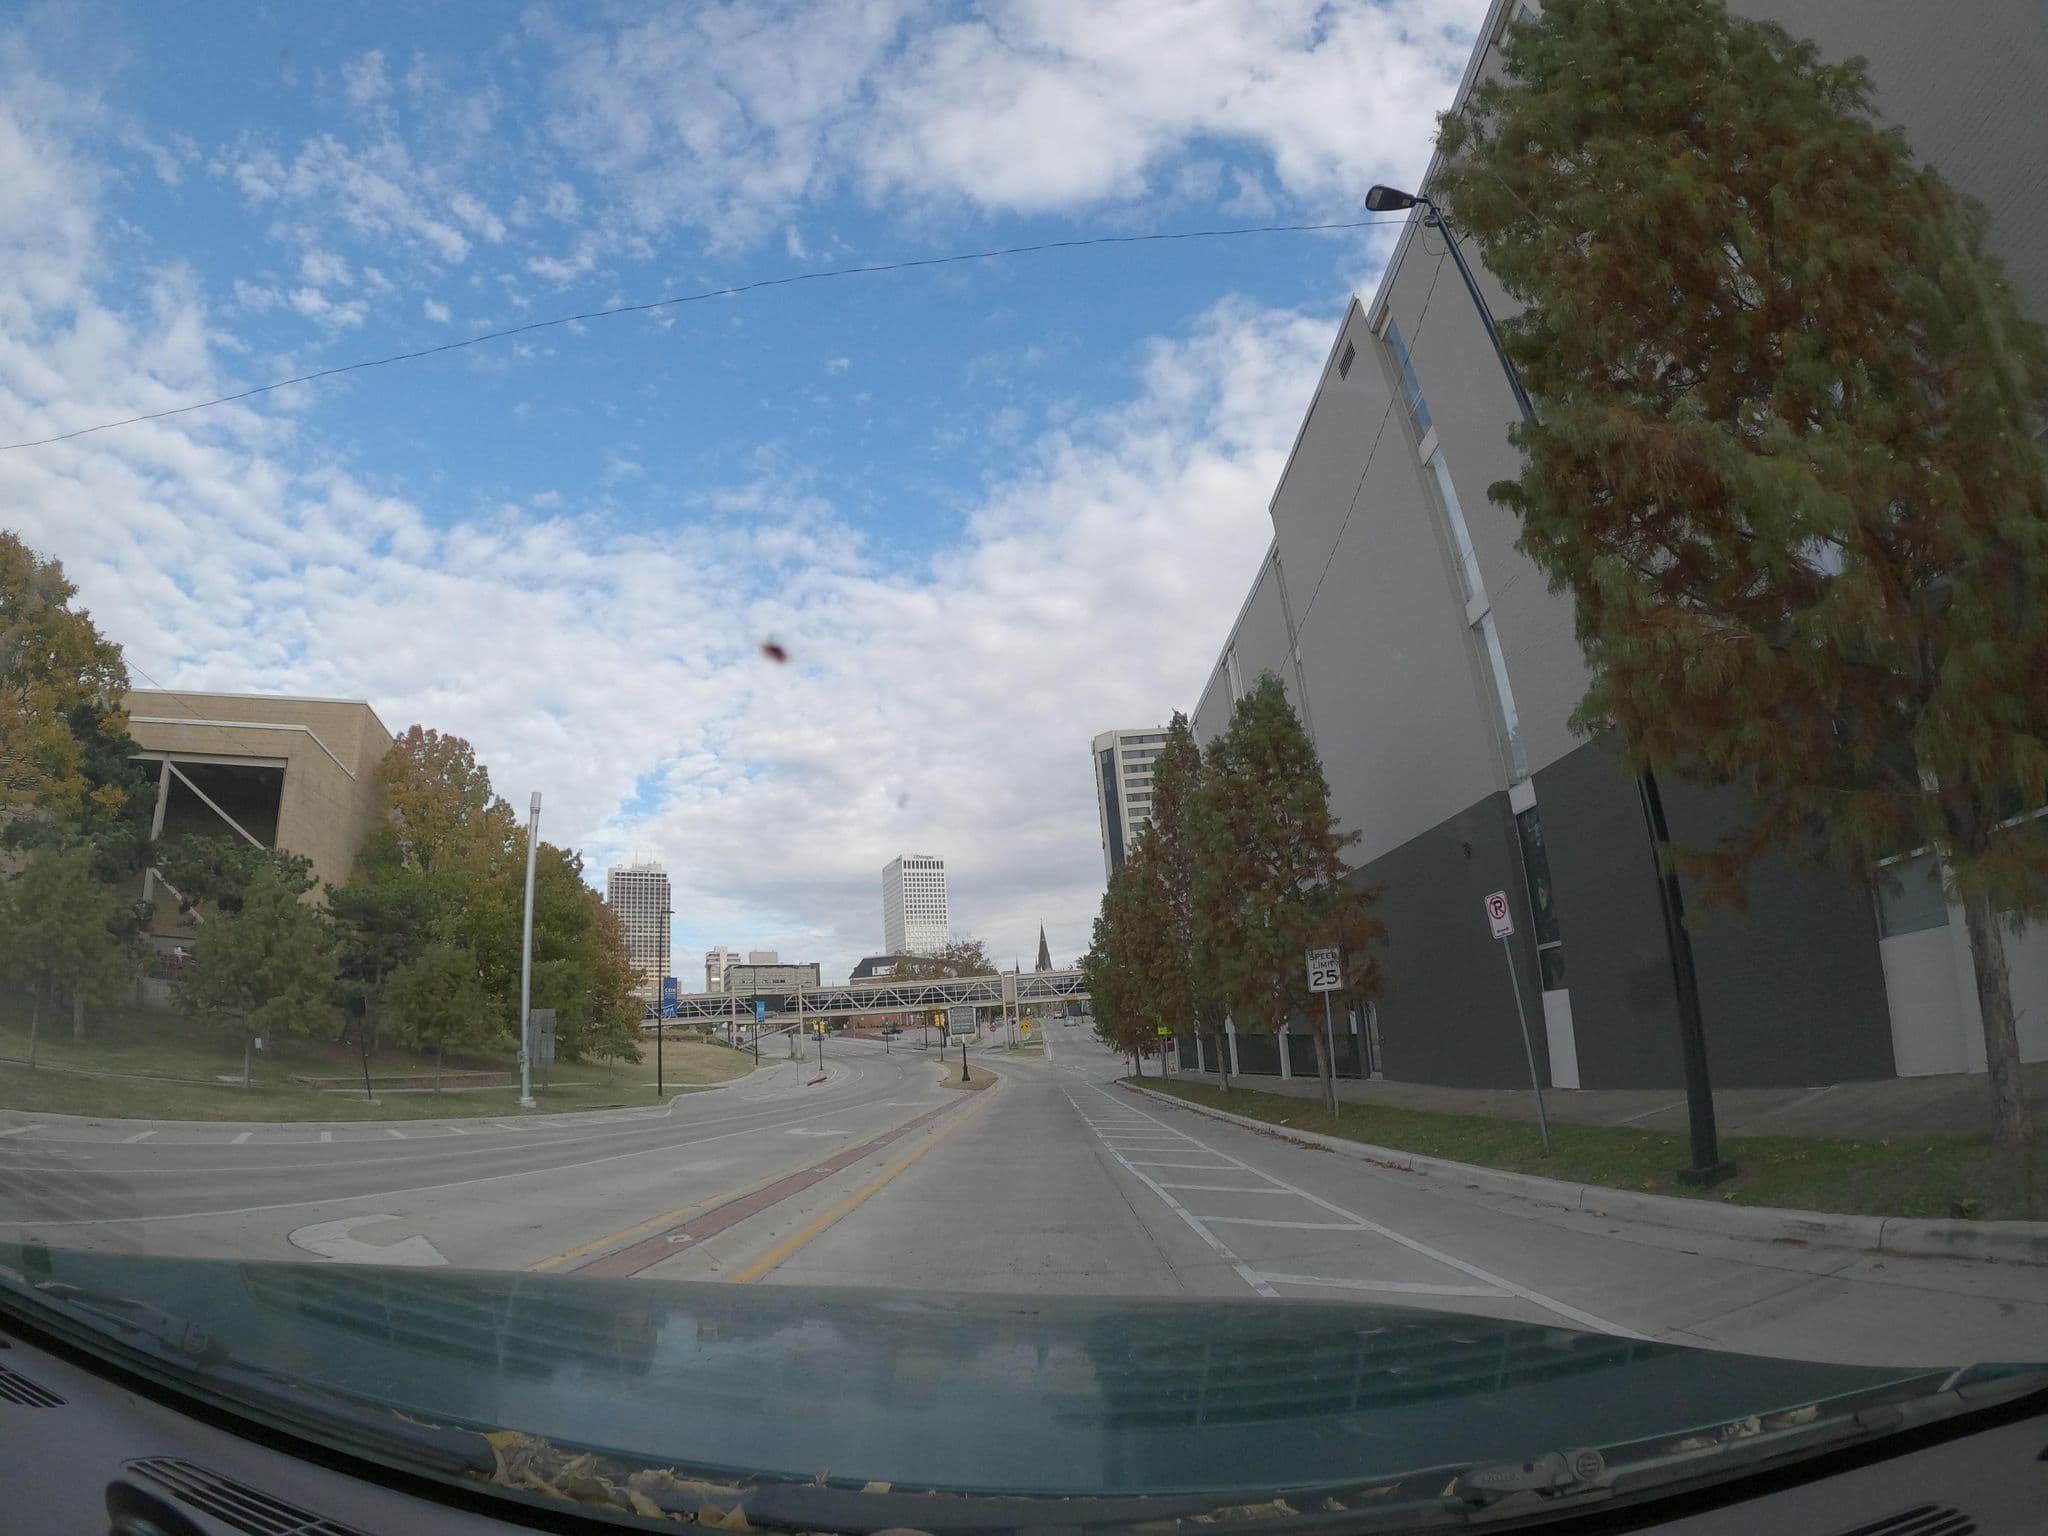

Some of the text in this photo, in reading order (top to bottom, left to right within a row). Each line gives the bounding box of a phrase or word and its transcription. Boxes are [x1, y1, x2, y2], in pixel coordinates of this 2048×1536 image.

[1309, 952, 1337, 961] SPEED
[1312, 960, 1337, 969] LIMIT
[1312, 969, 1338, 986] 25
